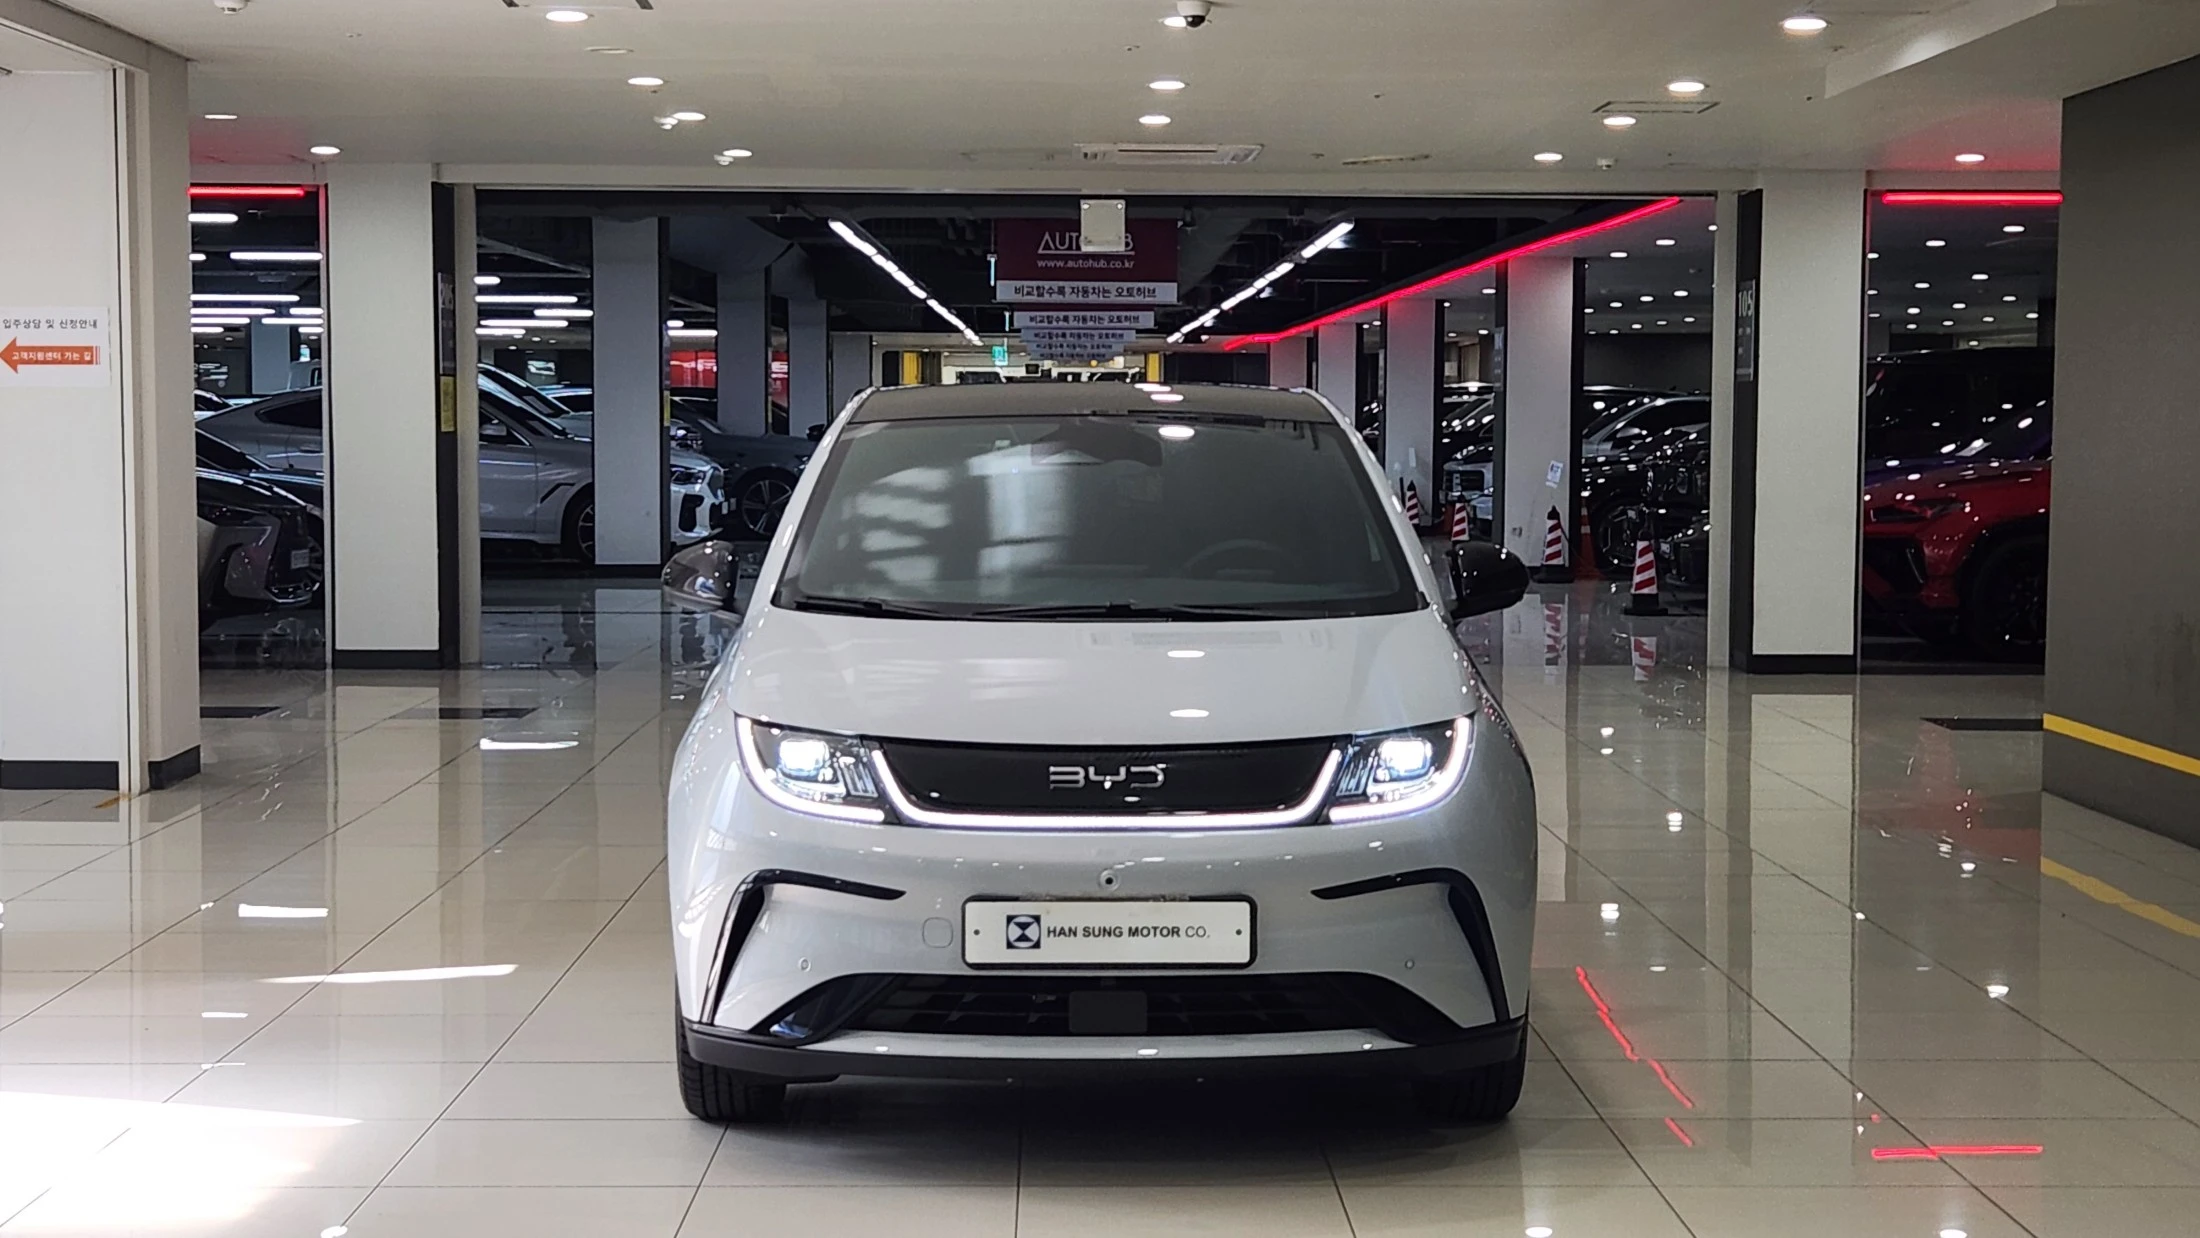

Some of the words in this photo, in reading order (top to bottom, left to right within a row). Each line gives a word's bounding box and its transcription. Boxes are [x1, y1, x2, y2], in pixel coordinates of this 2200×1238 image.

[1038, 232, 1134, 251] AUTB
[1037, 259, 1135, 268] www.autohub.co.kr
[1014, 285, 1066, 298] 비교할수록
[1069, 285, 1111, 298] 자동차는
[1114, 285, 1157, 298] 오토허브
[3, 319, 41, 329] 입주상담
[45, 319, 54, 329] 및
[59, 319, 98, 329] 신청안내
[1072, 314, 1105, 325] 자동차는
[1107, 314, 1140, 325] 오토허브
[1049, 765, 1166, 789] BYD
[1047, 926, 1078, 938] HAN
[1082, 926, 1124, 938] SUNG
[1128, 926, 1181, 938] MOTOR
[1184, 926, 1210, 939] CO.
